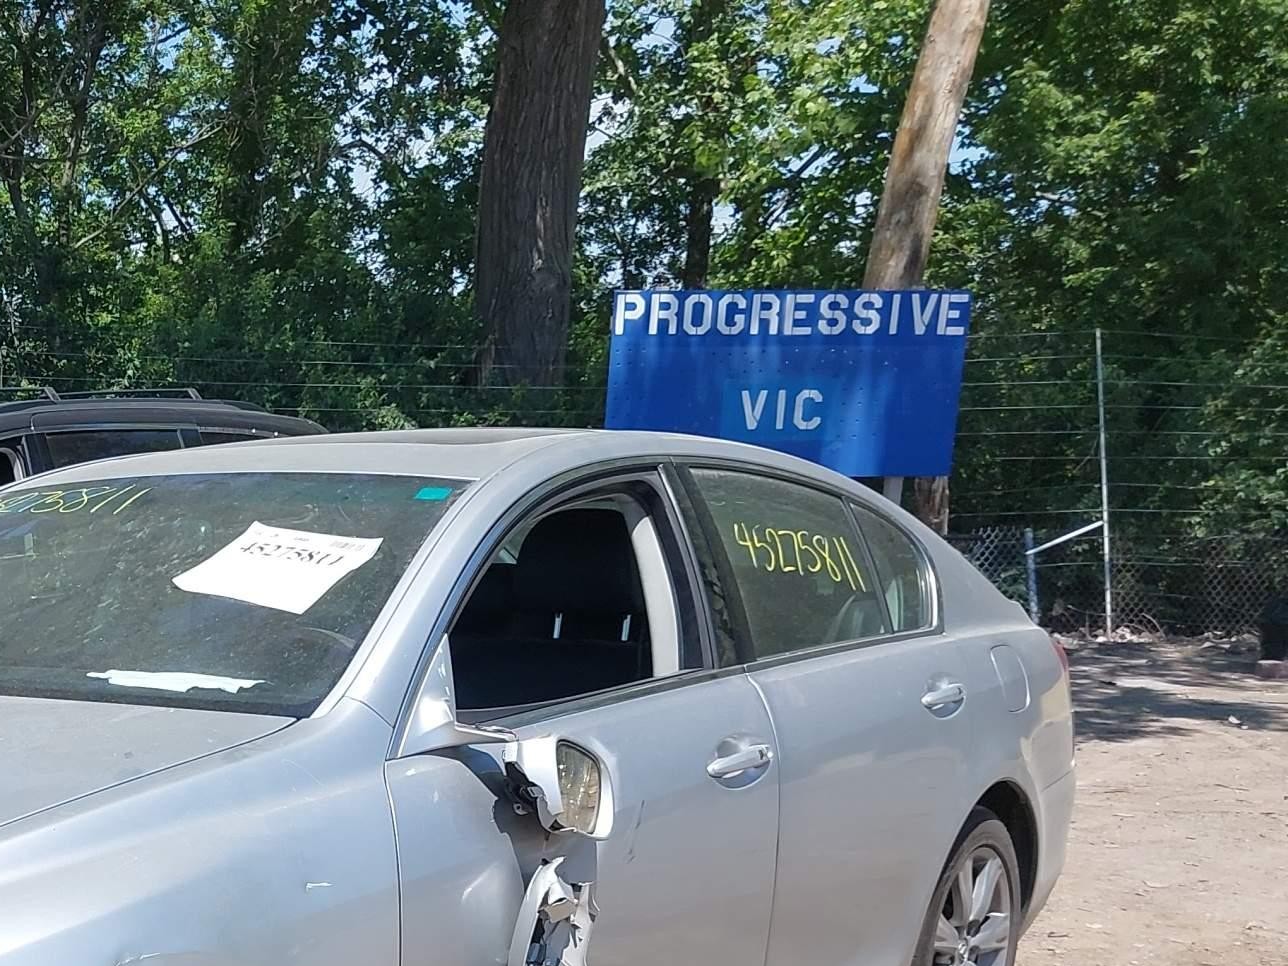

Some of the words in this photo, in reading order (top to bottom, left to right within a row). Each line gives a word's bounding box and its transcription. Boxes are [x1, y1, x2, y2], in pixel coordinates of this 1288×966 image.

[614, 292, 971, 336] PROGRESSIVE
[741, 388, 824, 431] VIC
[733, 521, 867, 593] 45275811
